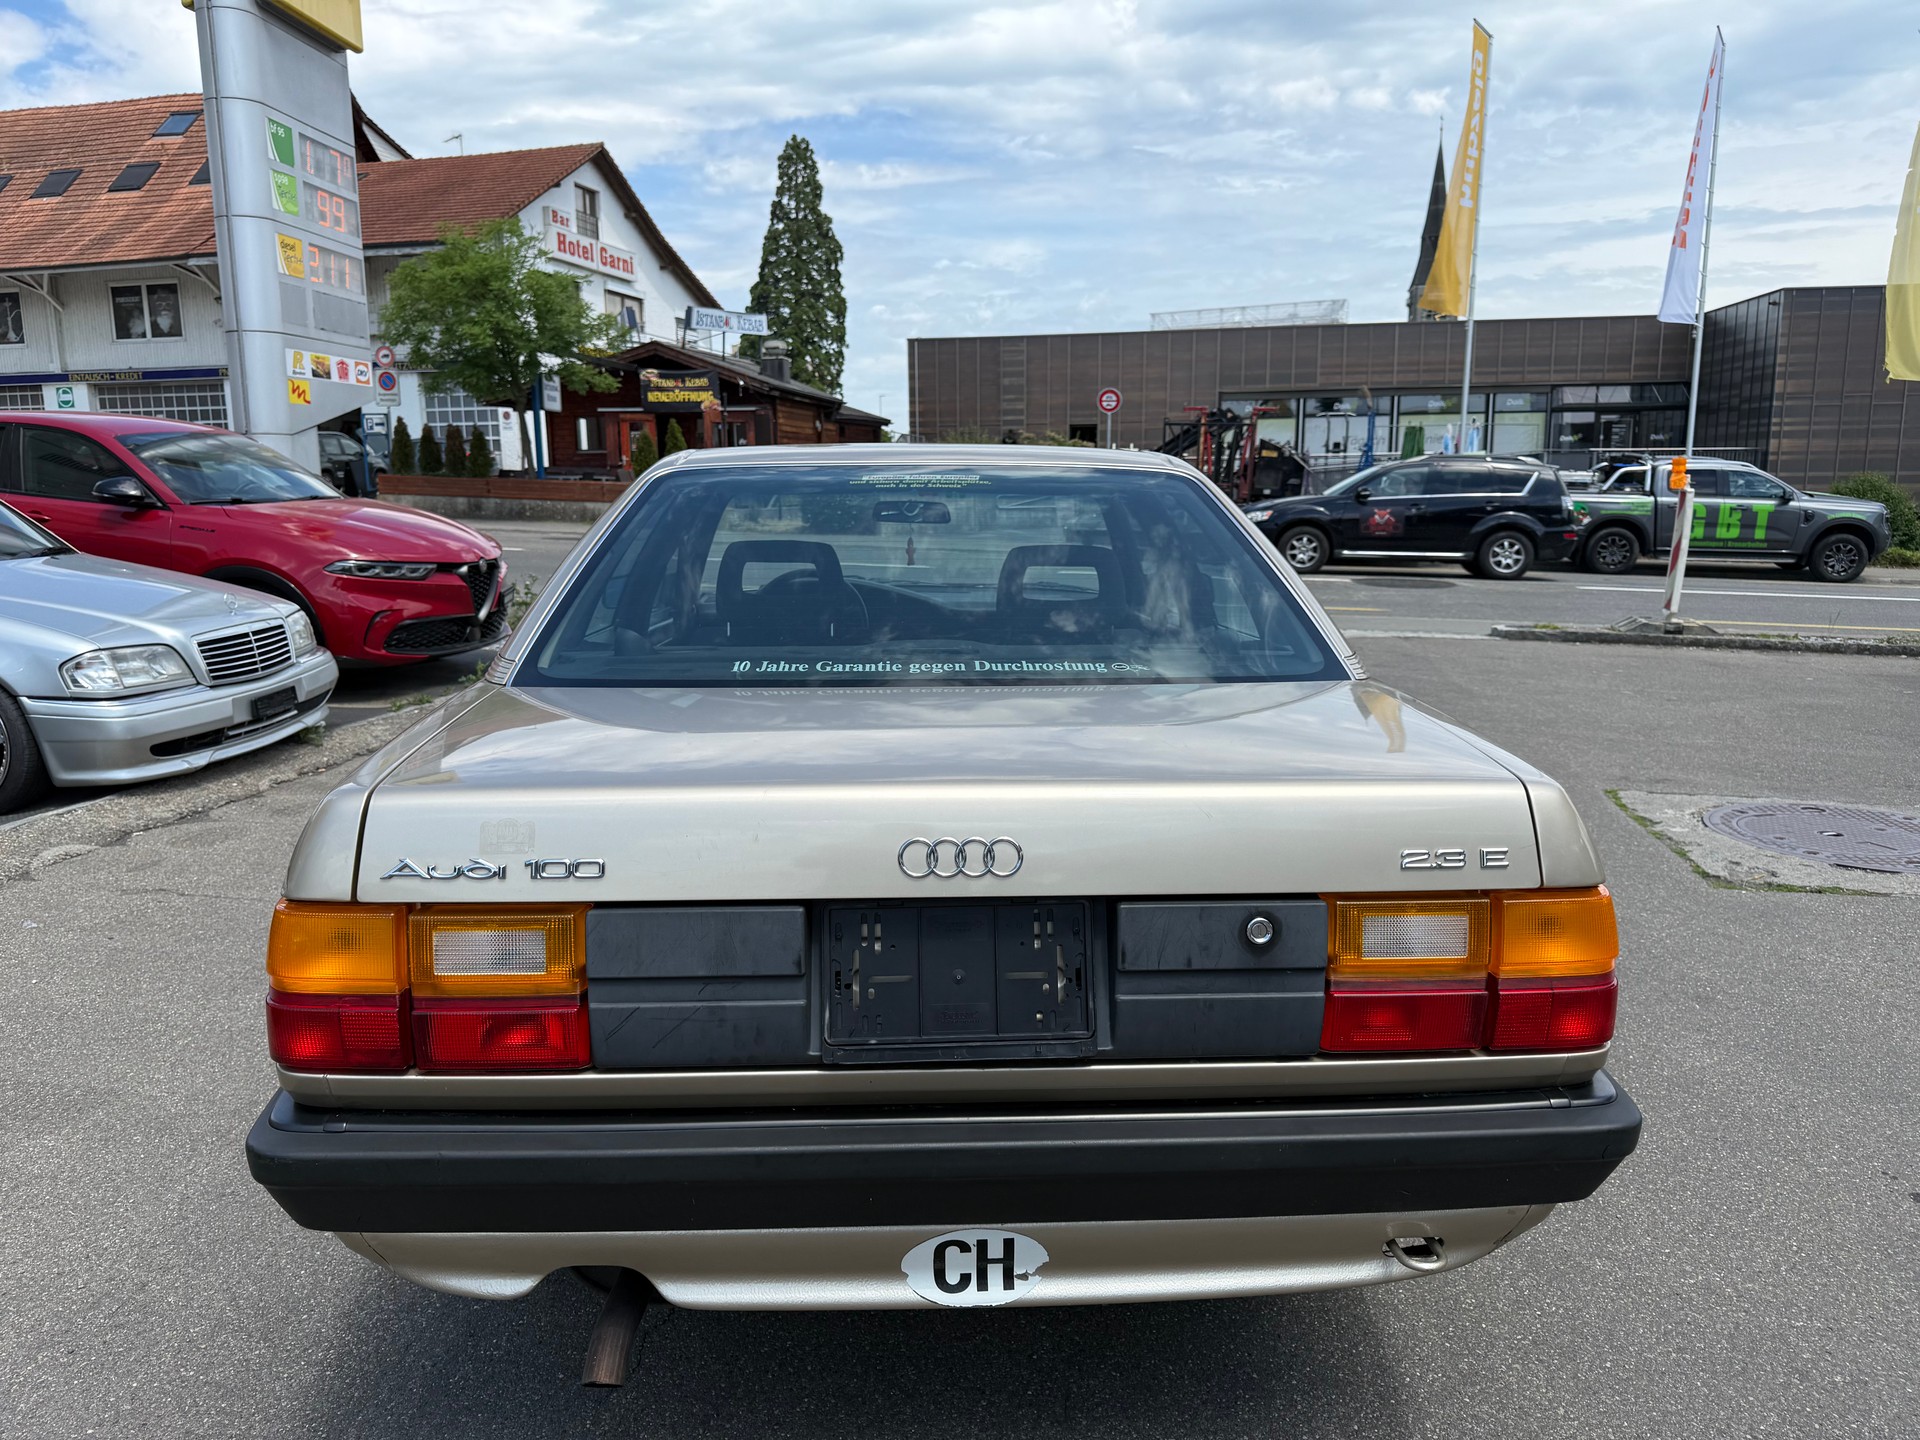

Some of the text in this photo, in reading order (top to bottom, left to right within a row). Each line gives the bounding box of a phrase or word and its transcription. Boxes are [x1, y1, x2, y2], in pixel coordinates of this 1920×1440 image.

[551, 209, 569, 228] Bar
[556, 231, 635, 275] Hotel Garni
[731, 660, 751, 672] 10
[755, 660, 809, 673] Jahre
[815, 660, 902, 672] Garantie
[909, 662, 966, 674] gegen
[974, 660, 1108, 673] Durchrostung
[379, 857, 606, 880] Audi 100
[1480, 847, 1510, 868] E
[933, 1237, 1016, 1294] CH
